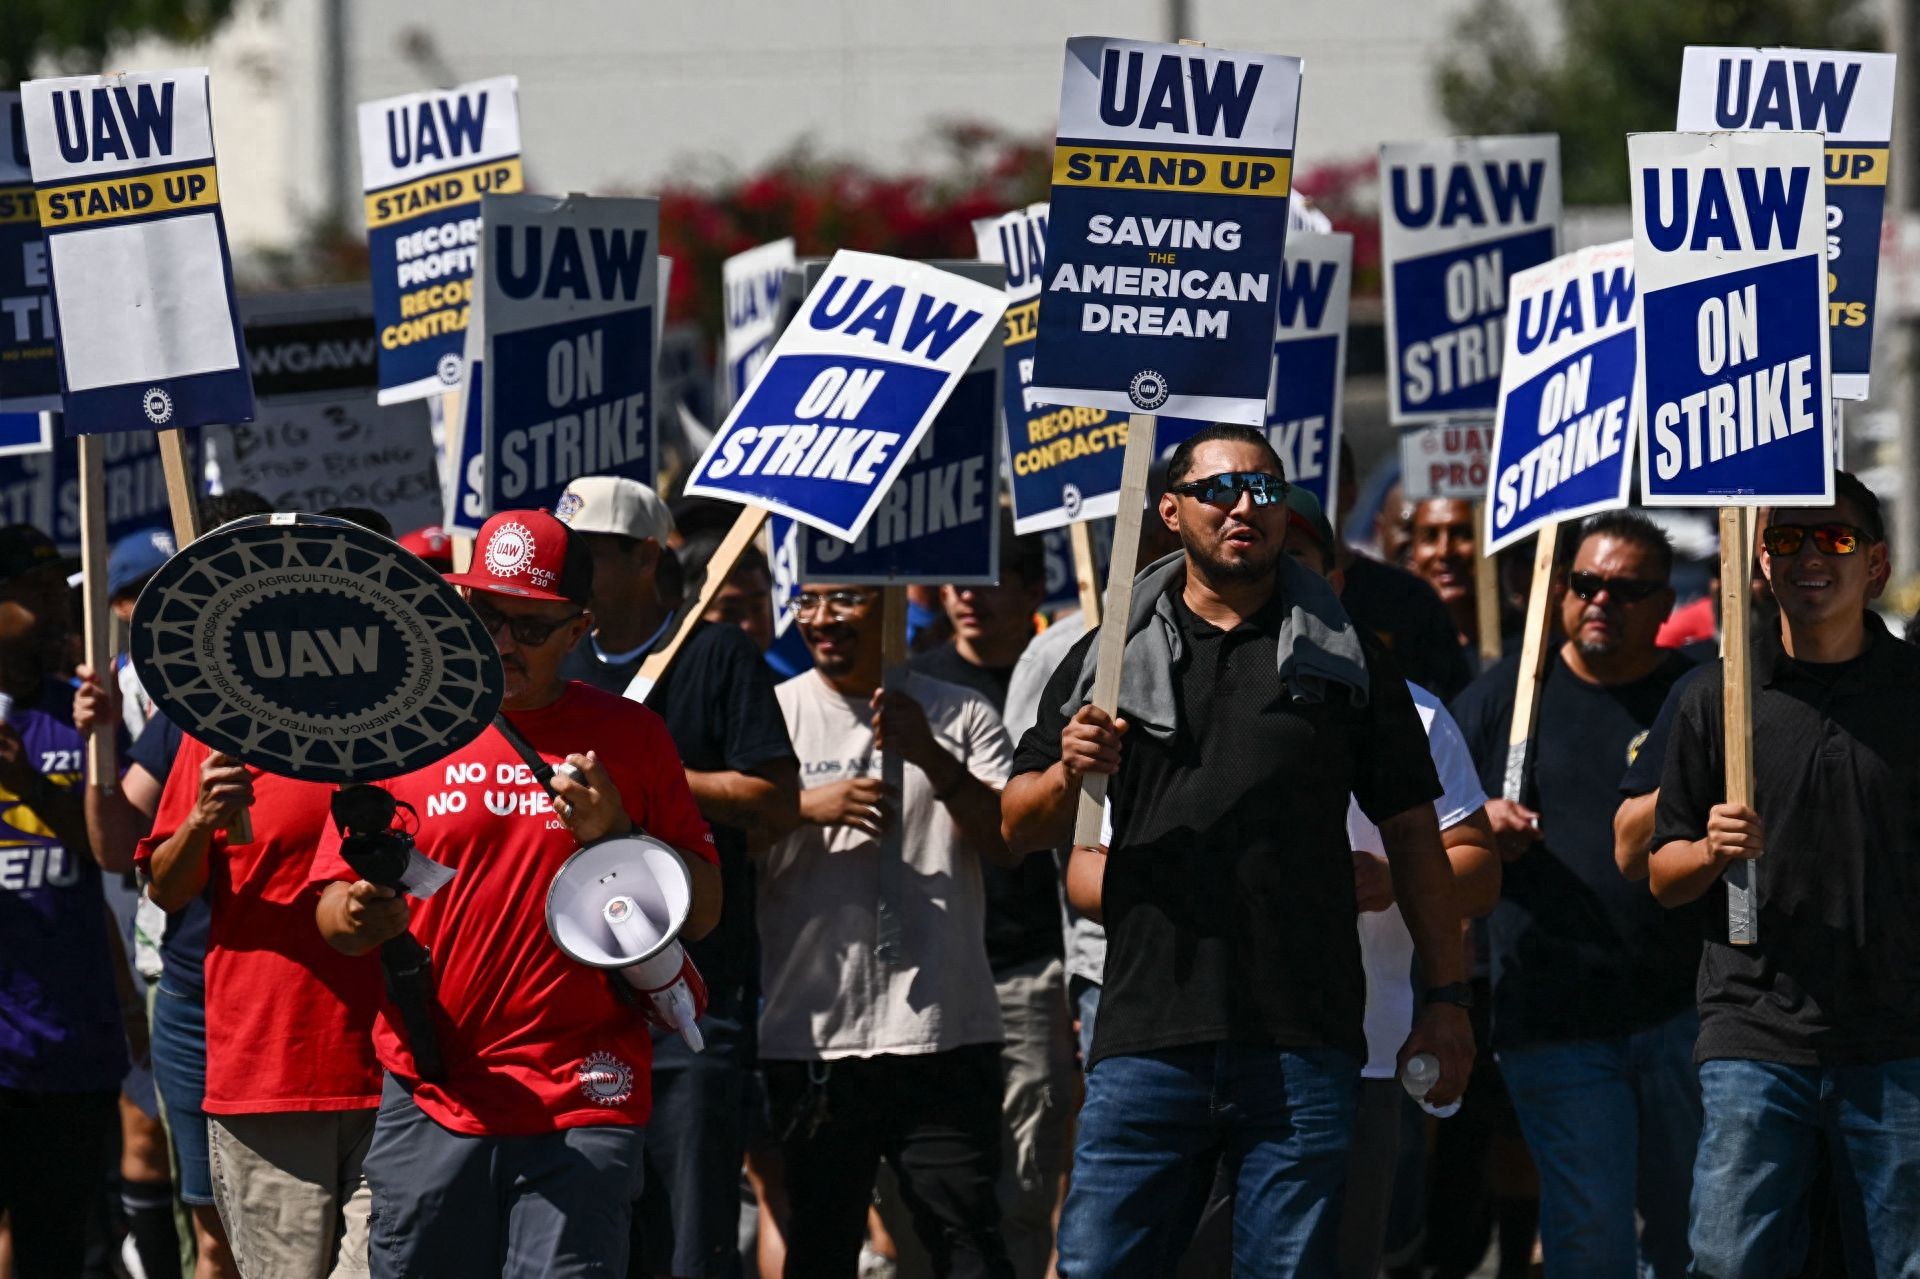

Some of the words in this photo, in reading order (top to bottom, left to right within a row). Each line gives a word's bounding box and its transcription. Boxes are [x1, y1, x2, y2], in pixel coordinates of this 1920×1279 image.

[1100, 49, 1264, 139] UAW
[1714, 59, 1862, 133] UAW
[51, 81, 175, 164] UAW
[387, 91, 488, 169] UAW
[1066, 153, 1206, 186] STAND
[1221, 161, 1276, 190] UP
[1824, 154, 1874, 179] UP
[48, 182, 154, 220] STAND
[164, 174, 206, 204] UP
[376, 179, 463, 220] STAND
[473, 168, 511, 194] UP
[1391, 158, 1547, 229] UAW
[1642, 166, 1811, 253] UAW
[396, 216, 484, 262] RECOR
[1000, 216, 1048, 288] UA
[1087, 214, 1242, 252] SAVING
[1148, 252, 1176, 265] THE
[495, 224, 648, 302] UAW
[1049, 262, 1270, 303] AMERICAN
[1446, 250, 1504, 323] ON
[401, 278, 474, 318] RECO
[809, 275, 984, 362] UAW
[1081, 303, 1230, 340] DREAM
[1516, 266, 1636, 355] UAW
[1697, 283, 1759, 376] ON
[252, 339, 376, 375] WGAW
[547, 329, 603, 408] ON
[1403, 315, 1506, 405] STRI
[794, 366, 886, 421] ON
[1538, 353, 1594, 436] ON
[1654, 354, 1815, 481] STRIKE
[502, 392, 645, 499] STRIKE
[707, 424, 901, 485] STRIKE
[1495, 395, 1626, 530] STRIKE
[497, 543, 520, 557] UAW
[527, 566, 556, 581] LOCAL
[230, 583, 256, 601] AND
[257, 573, 366, 594] AGRICULTURAL
[530, 577, 548, 588] 230
[203, 599, 232, 659] AEROSPACE
[370, 589, 429, 645] IMPLEMENT
[243, 625, 380, 679] UAW
[412, 648, 433, 697] WORKERS
[208, 661, 278, 721] AUTOMOBILE,
[402, 696, 417, 710] OF
[279, 718, 334, 736] UNITED
[339, 707, 401, 734] AMERICA
[41, 750, 81, 772] 721
[446, 763, 486, 785] NO
[804, 760, 842, 775] LOS
[427, 791, 466, 817] NO
